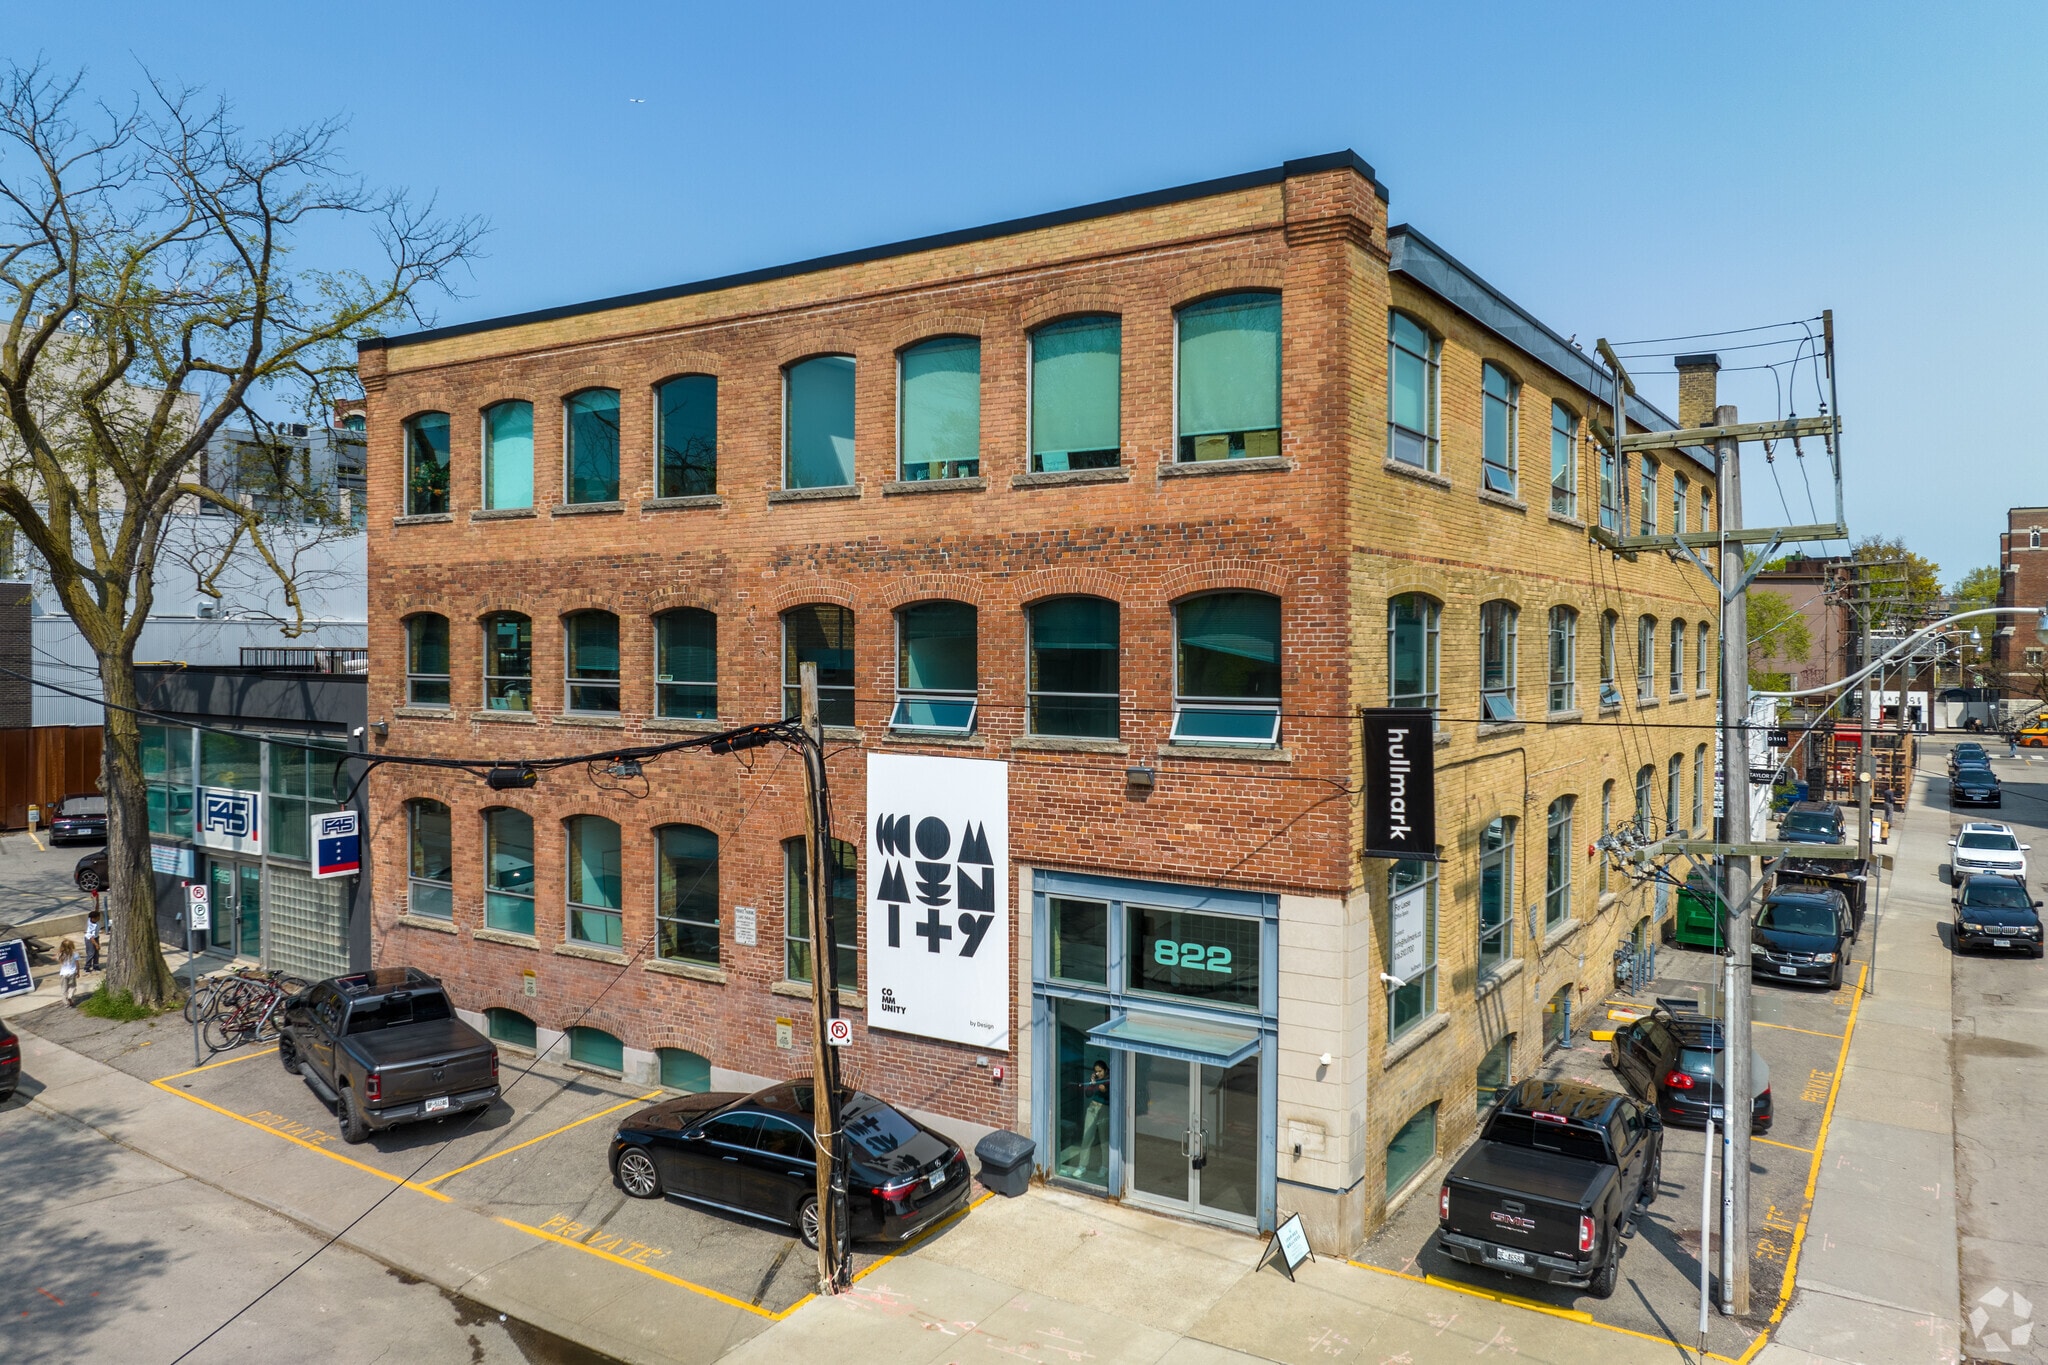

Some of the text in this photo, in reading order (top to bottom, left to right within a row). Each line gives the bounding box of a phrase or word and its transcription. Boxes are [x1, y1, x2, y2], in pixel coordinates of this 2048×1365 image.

[1387, 728, 1412, 841] hullmark
[205, 793, 249, 837] F45
[322, 815, 355, 835] F45
[1154, 939, 1232, 973] 822
[881, 987, 892, 996] CO
[881, 1003, 906, 1015] UNITY
[976, 1021, 994, 1030] Design
[1490, 1211, 1535, 1229] GMC
[538, 1212, 672, 1264] PRIVATE
